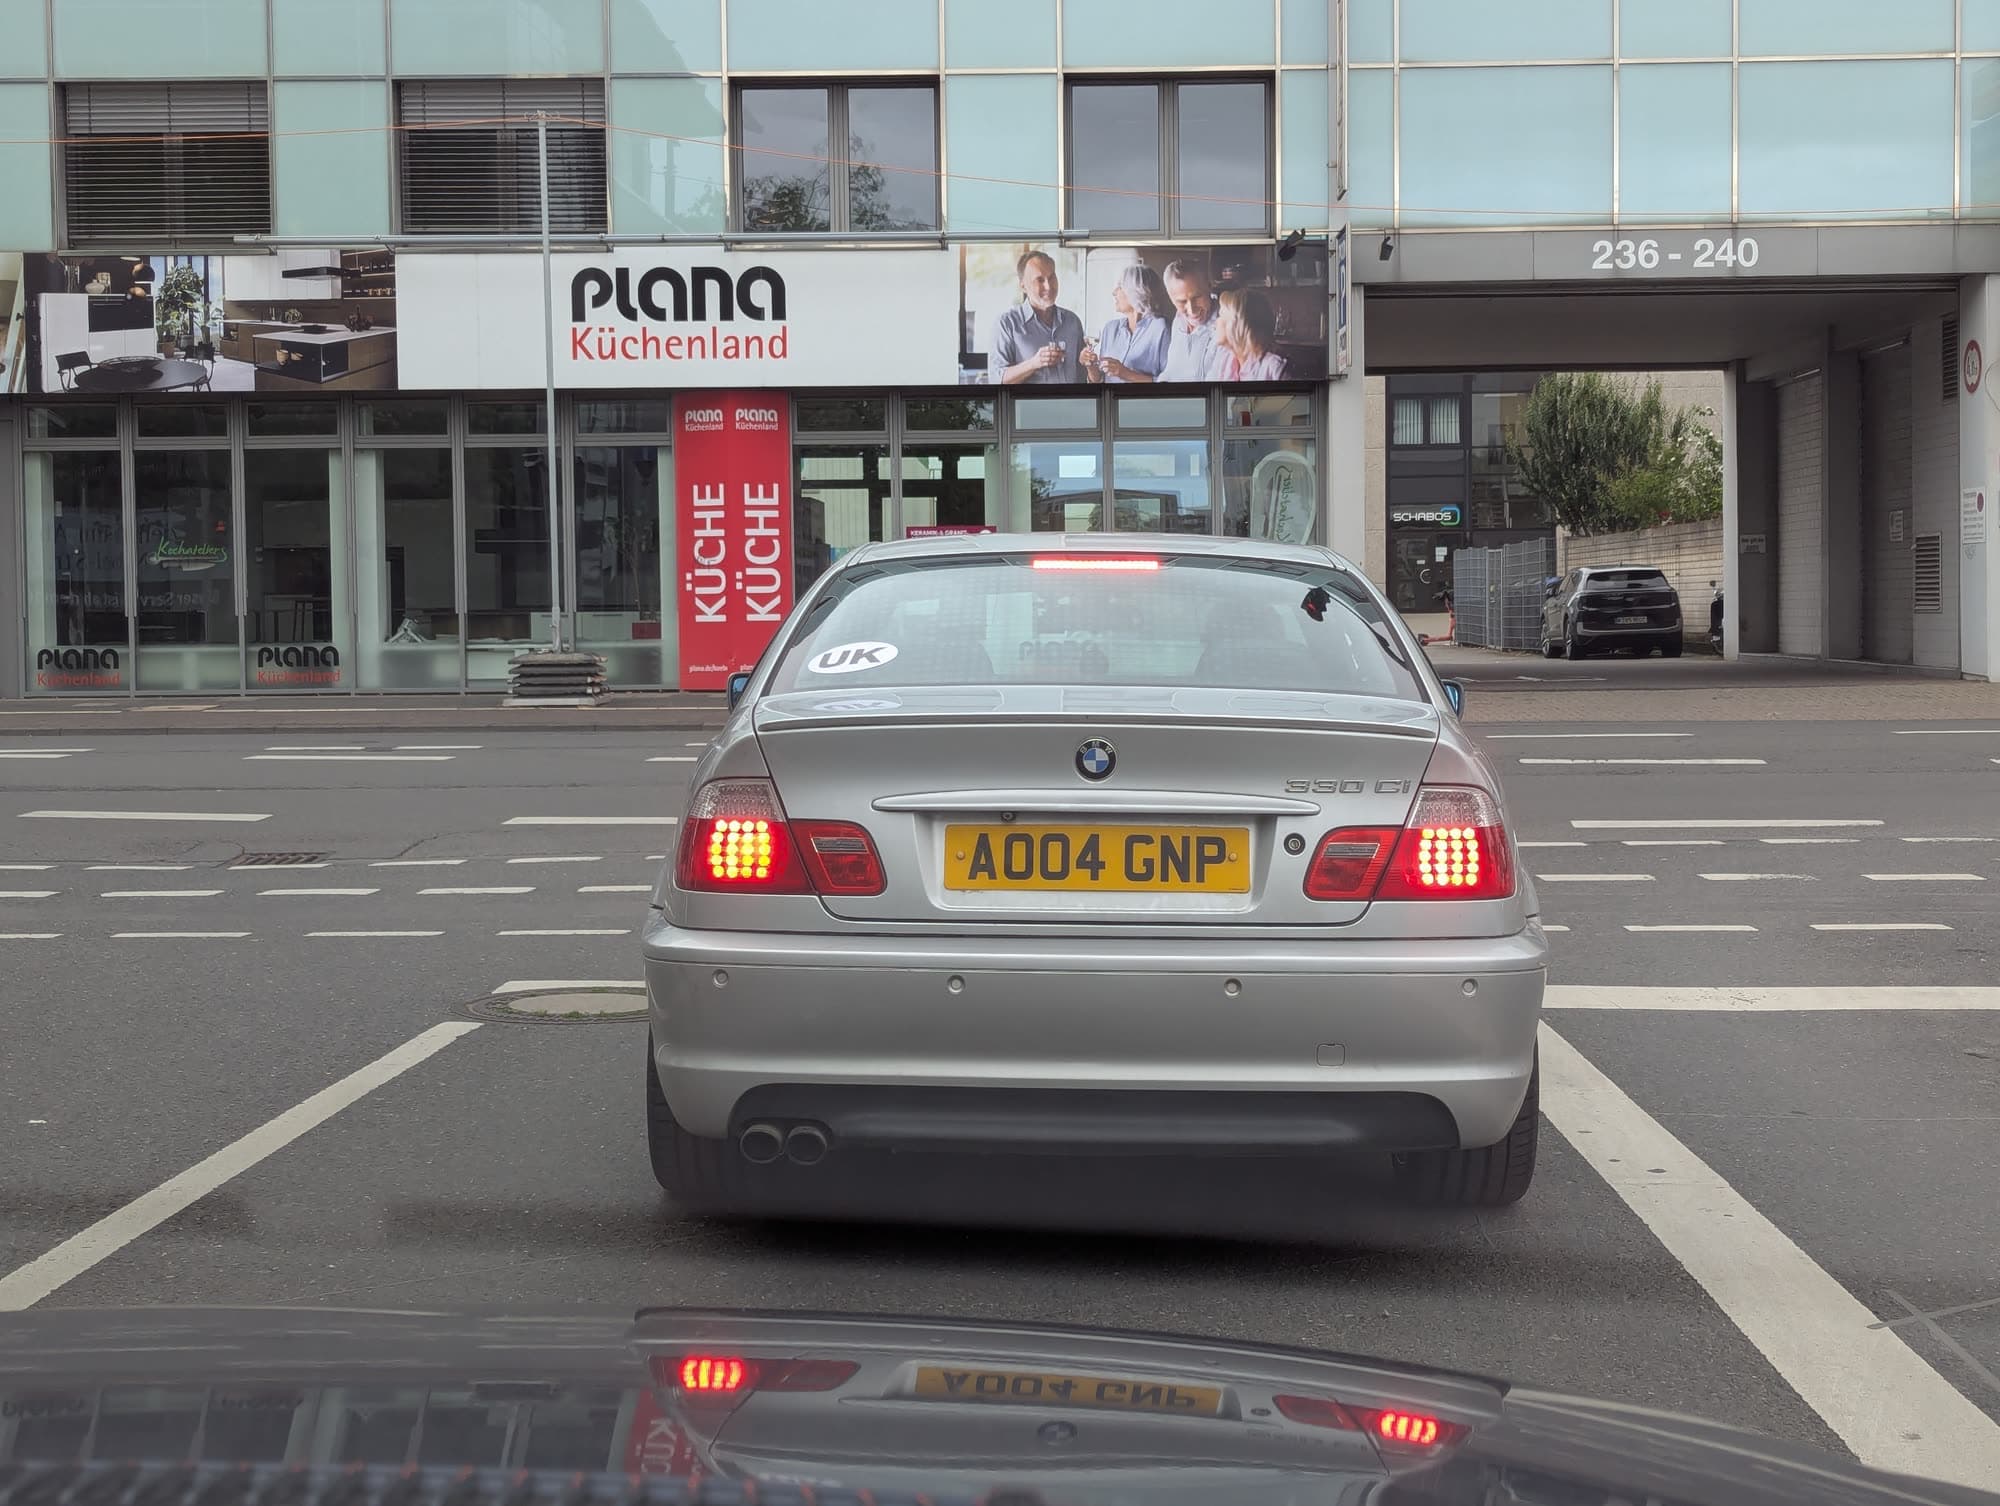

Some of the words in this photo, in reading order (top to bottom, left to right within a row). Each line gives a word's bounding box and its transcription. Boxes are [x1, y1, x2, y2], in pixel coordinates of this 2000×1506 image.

[1592, 239, 1660, 269] 236
[1693, 237, 1759, 268] 240
[571, 325, 788, 360] Küchenland
[685, 422, 723, 432] Küchenland
[735, 421, 778, 431] Küchenland
[1393, 512, 1452, 521] SCHABOS
[686, 483, 727, 623] KÜCHE
[735, 483, 781, 621] KÜCHE
[818, 646, 889, 669] UK
[36, 672, 121, 686] Küchenland
[256, 668, 341, 684] Küchenland
[1284, 778, 1366, 794] 330
[1124, 834, 1227, 883] GNP
